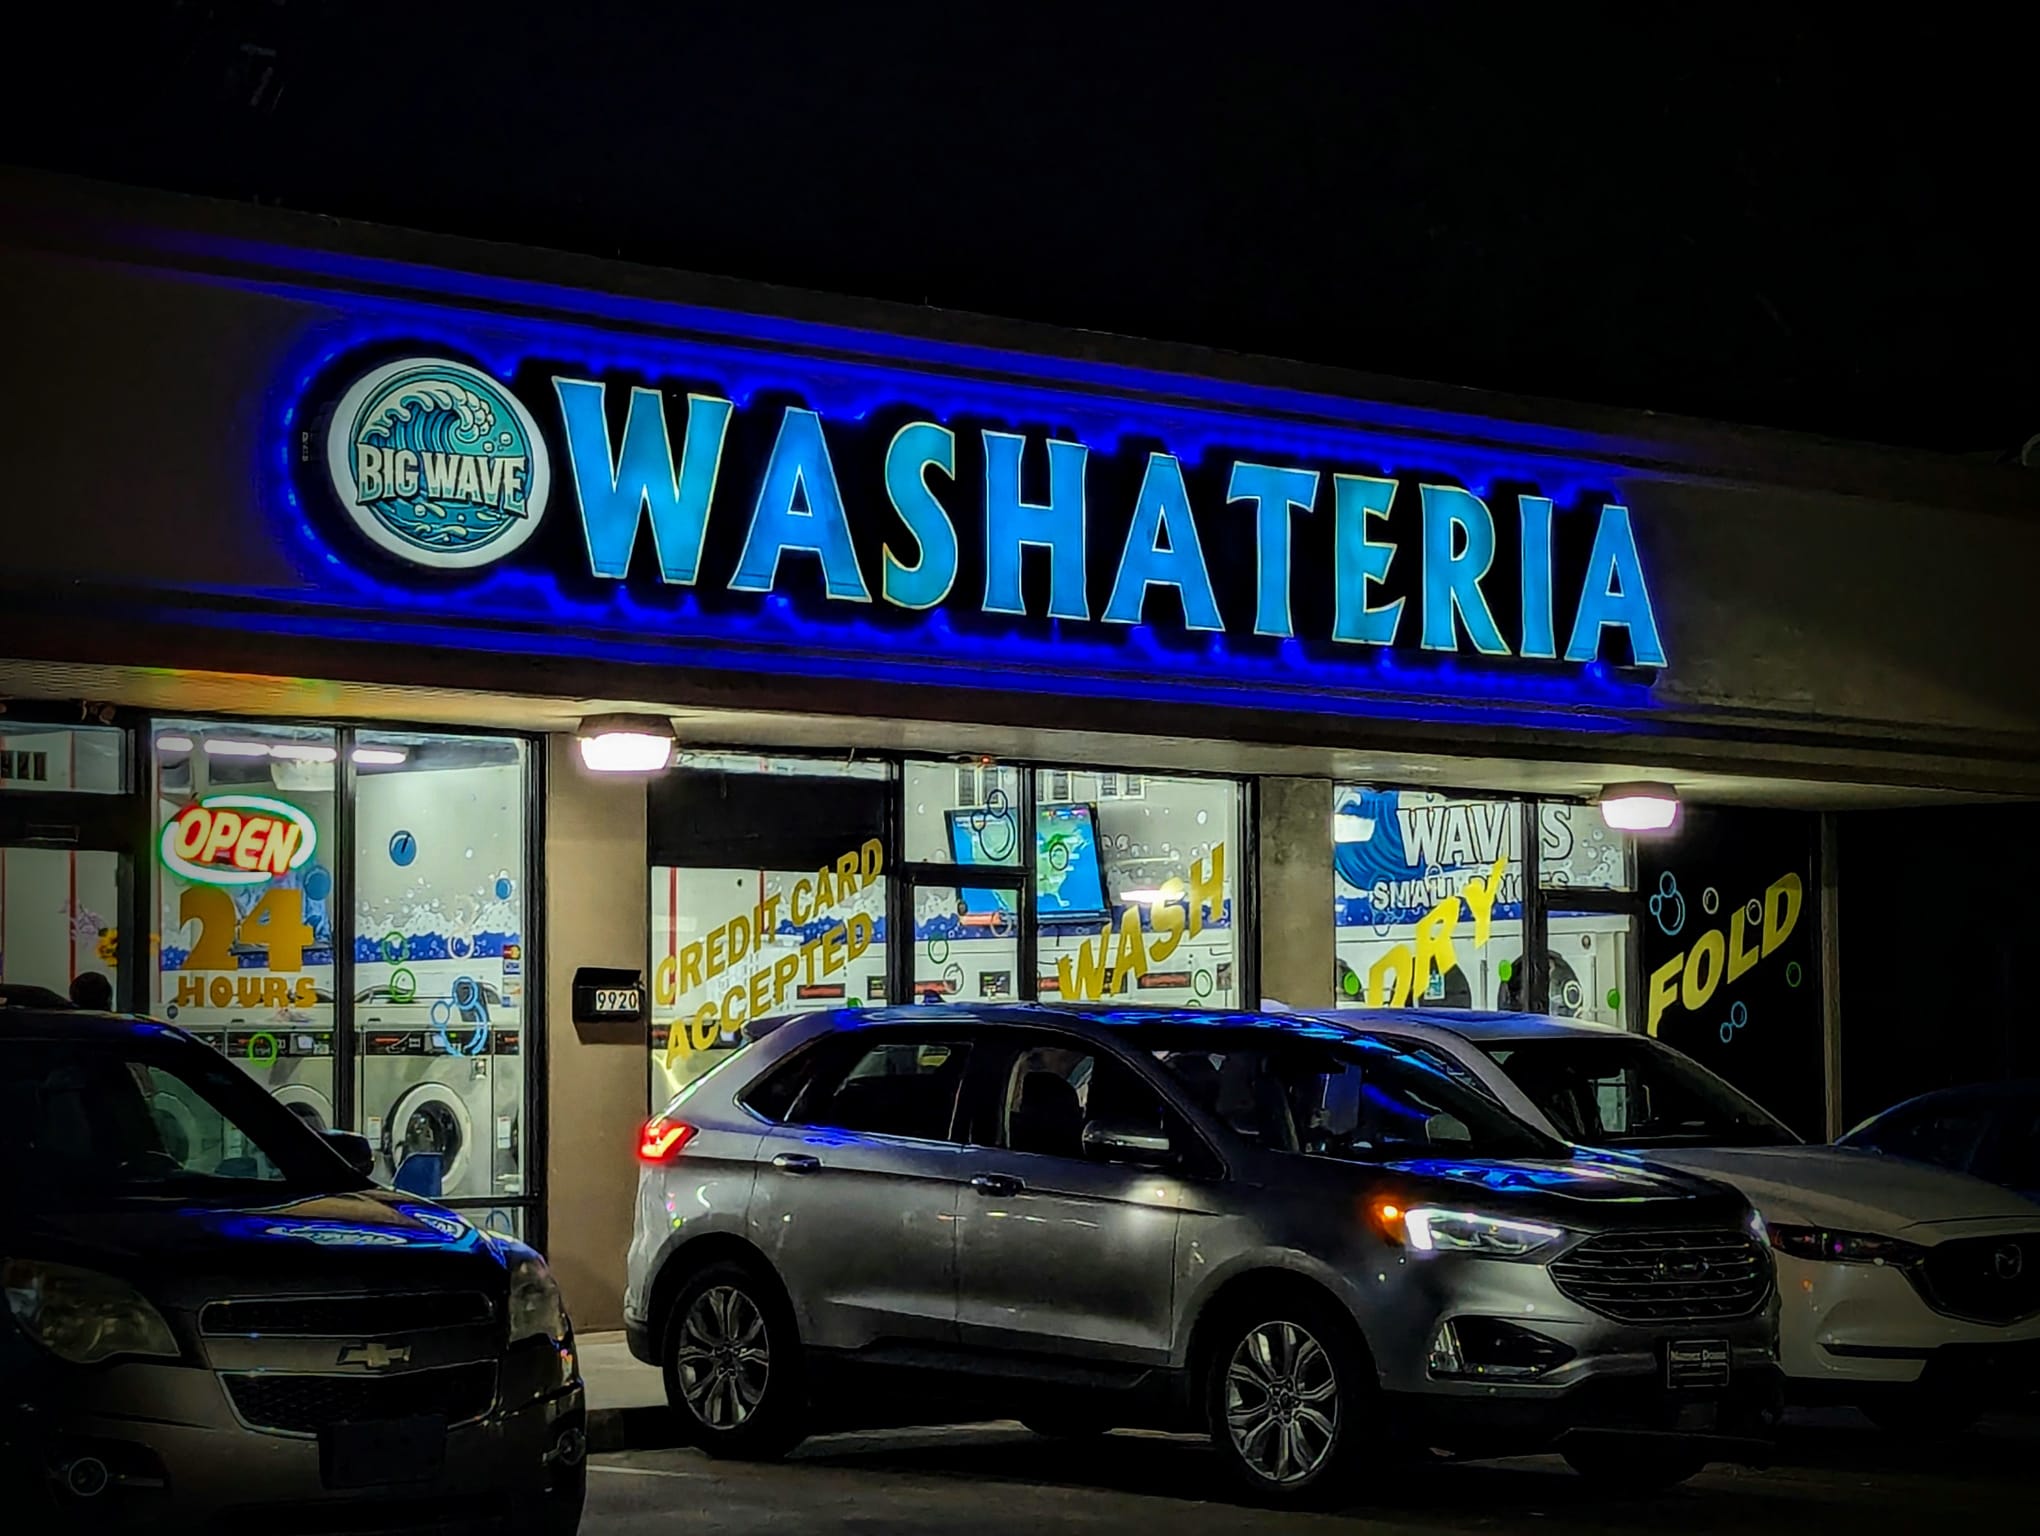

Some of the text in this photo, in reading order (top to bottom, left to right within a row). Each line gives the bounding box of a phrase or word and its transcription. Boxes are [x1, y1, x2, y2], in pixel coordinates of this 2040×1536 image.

[357, 443, 420, 503] BIG
[421, 451, 527, 516] WAVE
[551, 376, 1667, 668] WASHATERIA
[175, 808, 303, 873] OPEN
[177, 976, 318, 1008] HOURS
[179, 887, 314, 972] 24
[655, 838, 883, 1006] CREDIT CARD
[666, 912, 872, 1070] ACCEPTED
[1057, 842, 1225, 1001] WASH
[1366, 853, 1508, 1009] DRY
[1647, 872, 1803, 1038] FOLD
[597, 991, 638, 1010] 9920
